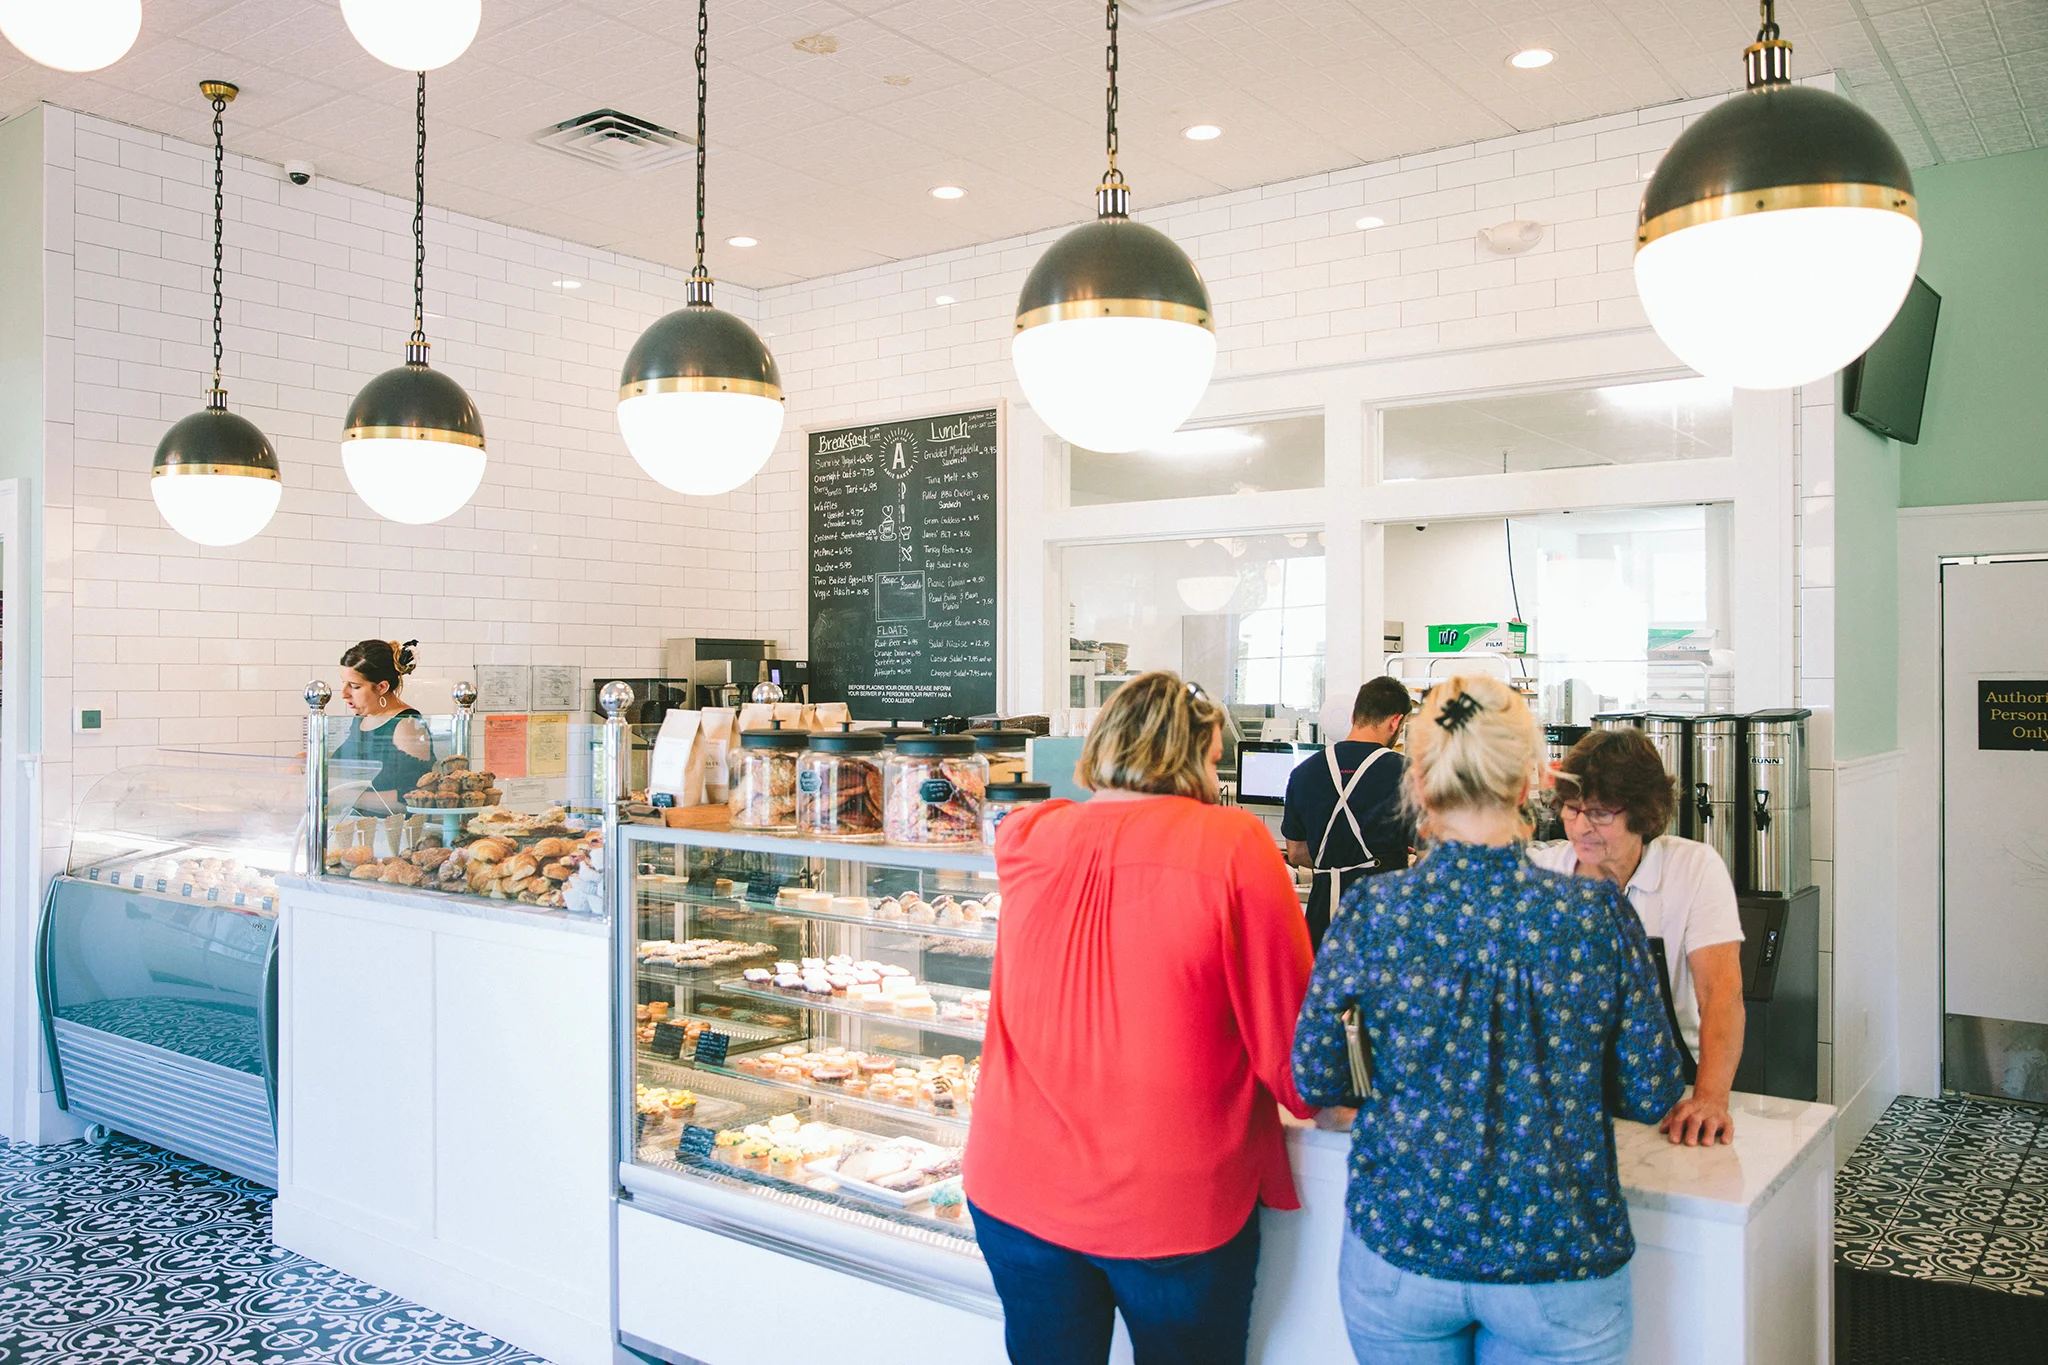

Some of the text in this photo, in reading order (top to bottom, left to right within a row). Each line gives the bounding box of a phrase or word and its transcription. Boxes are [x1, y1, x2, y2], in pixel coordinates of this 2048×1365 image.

[931, 418, 968, 440] Lunch
[819, 430, 868, 452] Breakfast
[892, 442, 906, 469] A
[883, 465, 914, 479] AMIE BAKERY
[943, 472, 958, 483] Melt
[814, 502, 838, 512] Waffles
[812, 576, 826, 585] Two
[828, 576, 847, 585] Baked
[877, 625, 909, 636] FLOATS
[1439, 629, 1459, 646] WP
[1991, 709, 2048, 721] Person
